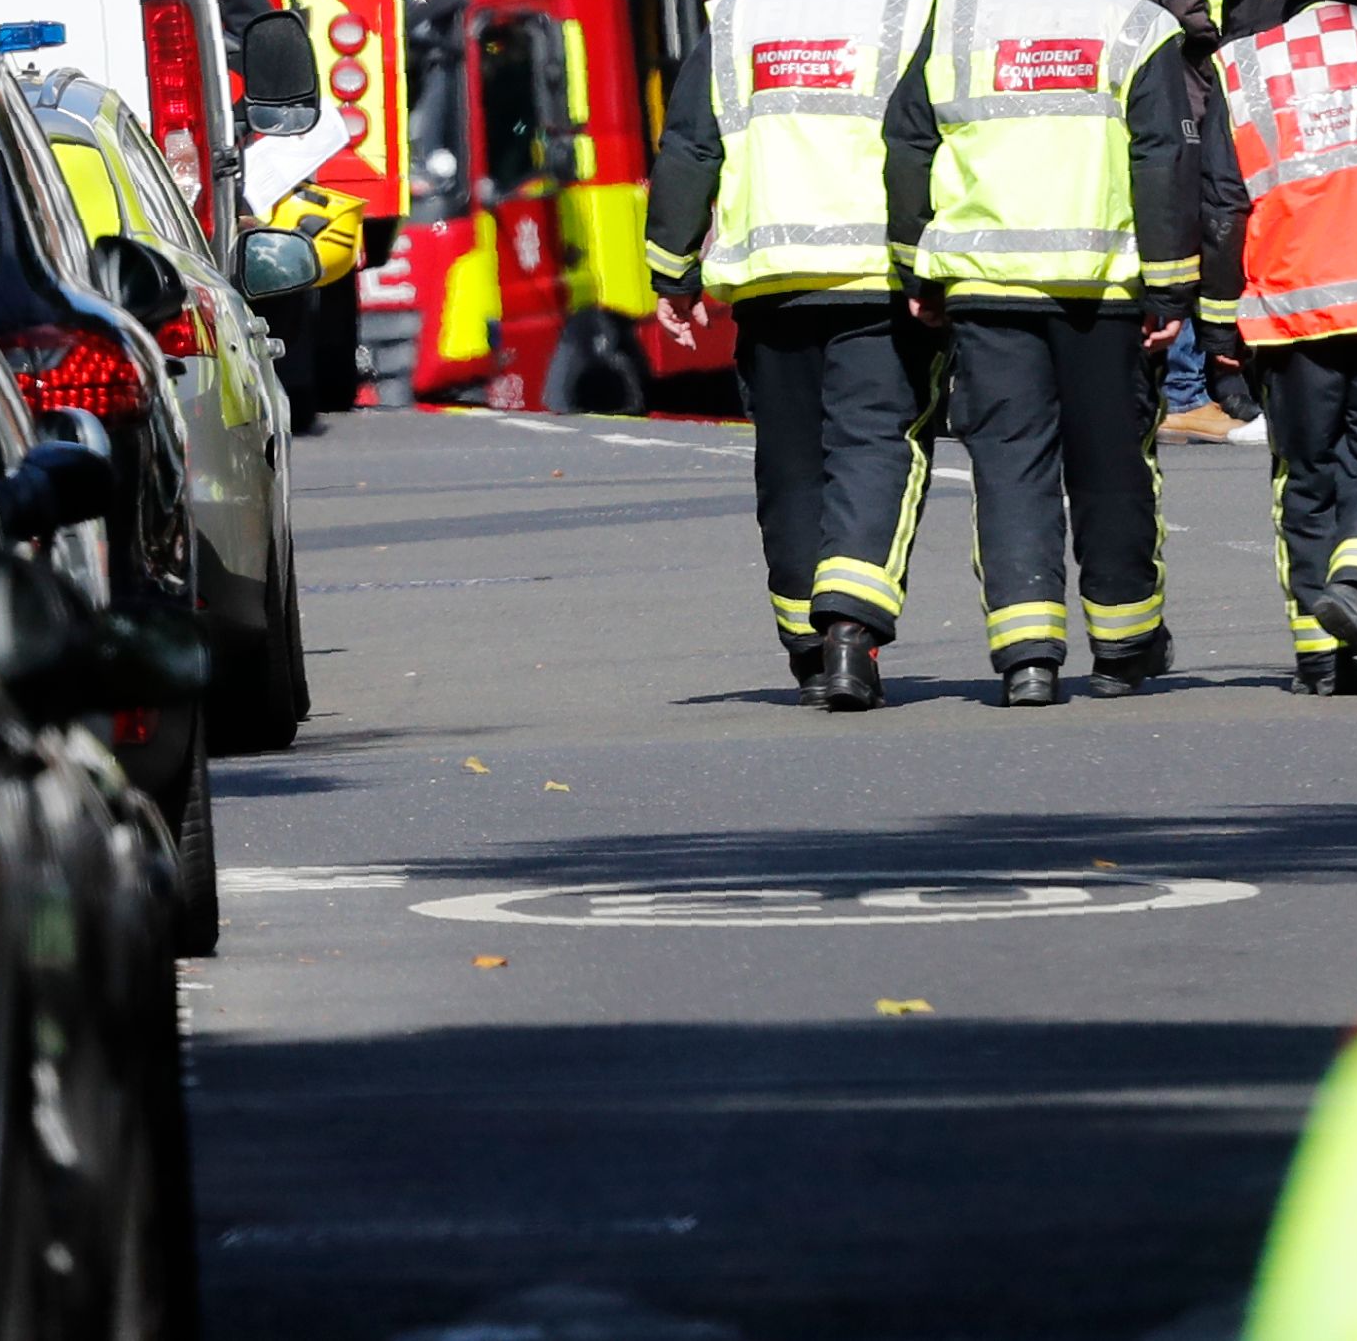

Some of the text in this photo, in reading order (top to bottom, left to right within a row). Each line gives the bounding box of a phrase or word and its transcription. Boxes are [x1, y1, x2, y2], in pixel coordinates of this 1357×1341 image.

[755, 48, 844, 64] MONITORIN
[1015, 49, 1082, 64] INCIDENT
[769, 62, 830, 76] OFFICER
[998, 63, 1094, 78] COMMANDER
